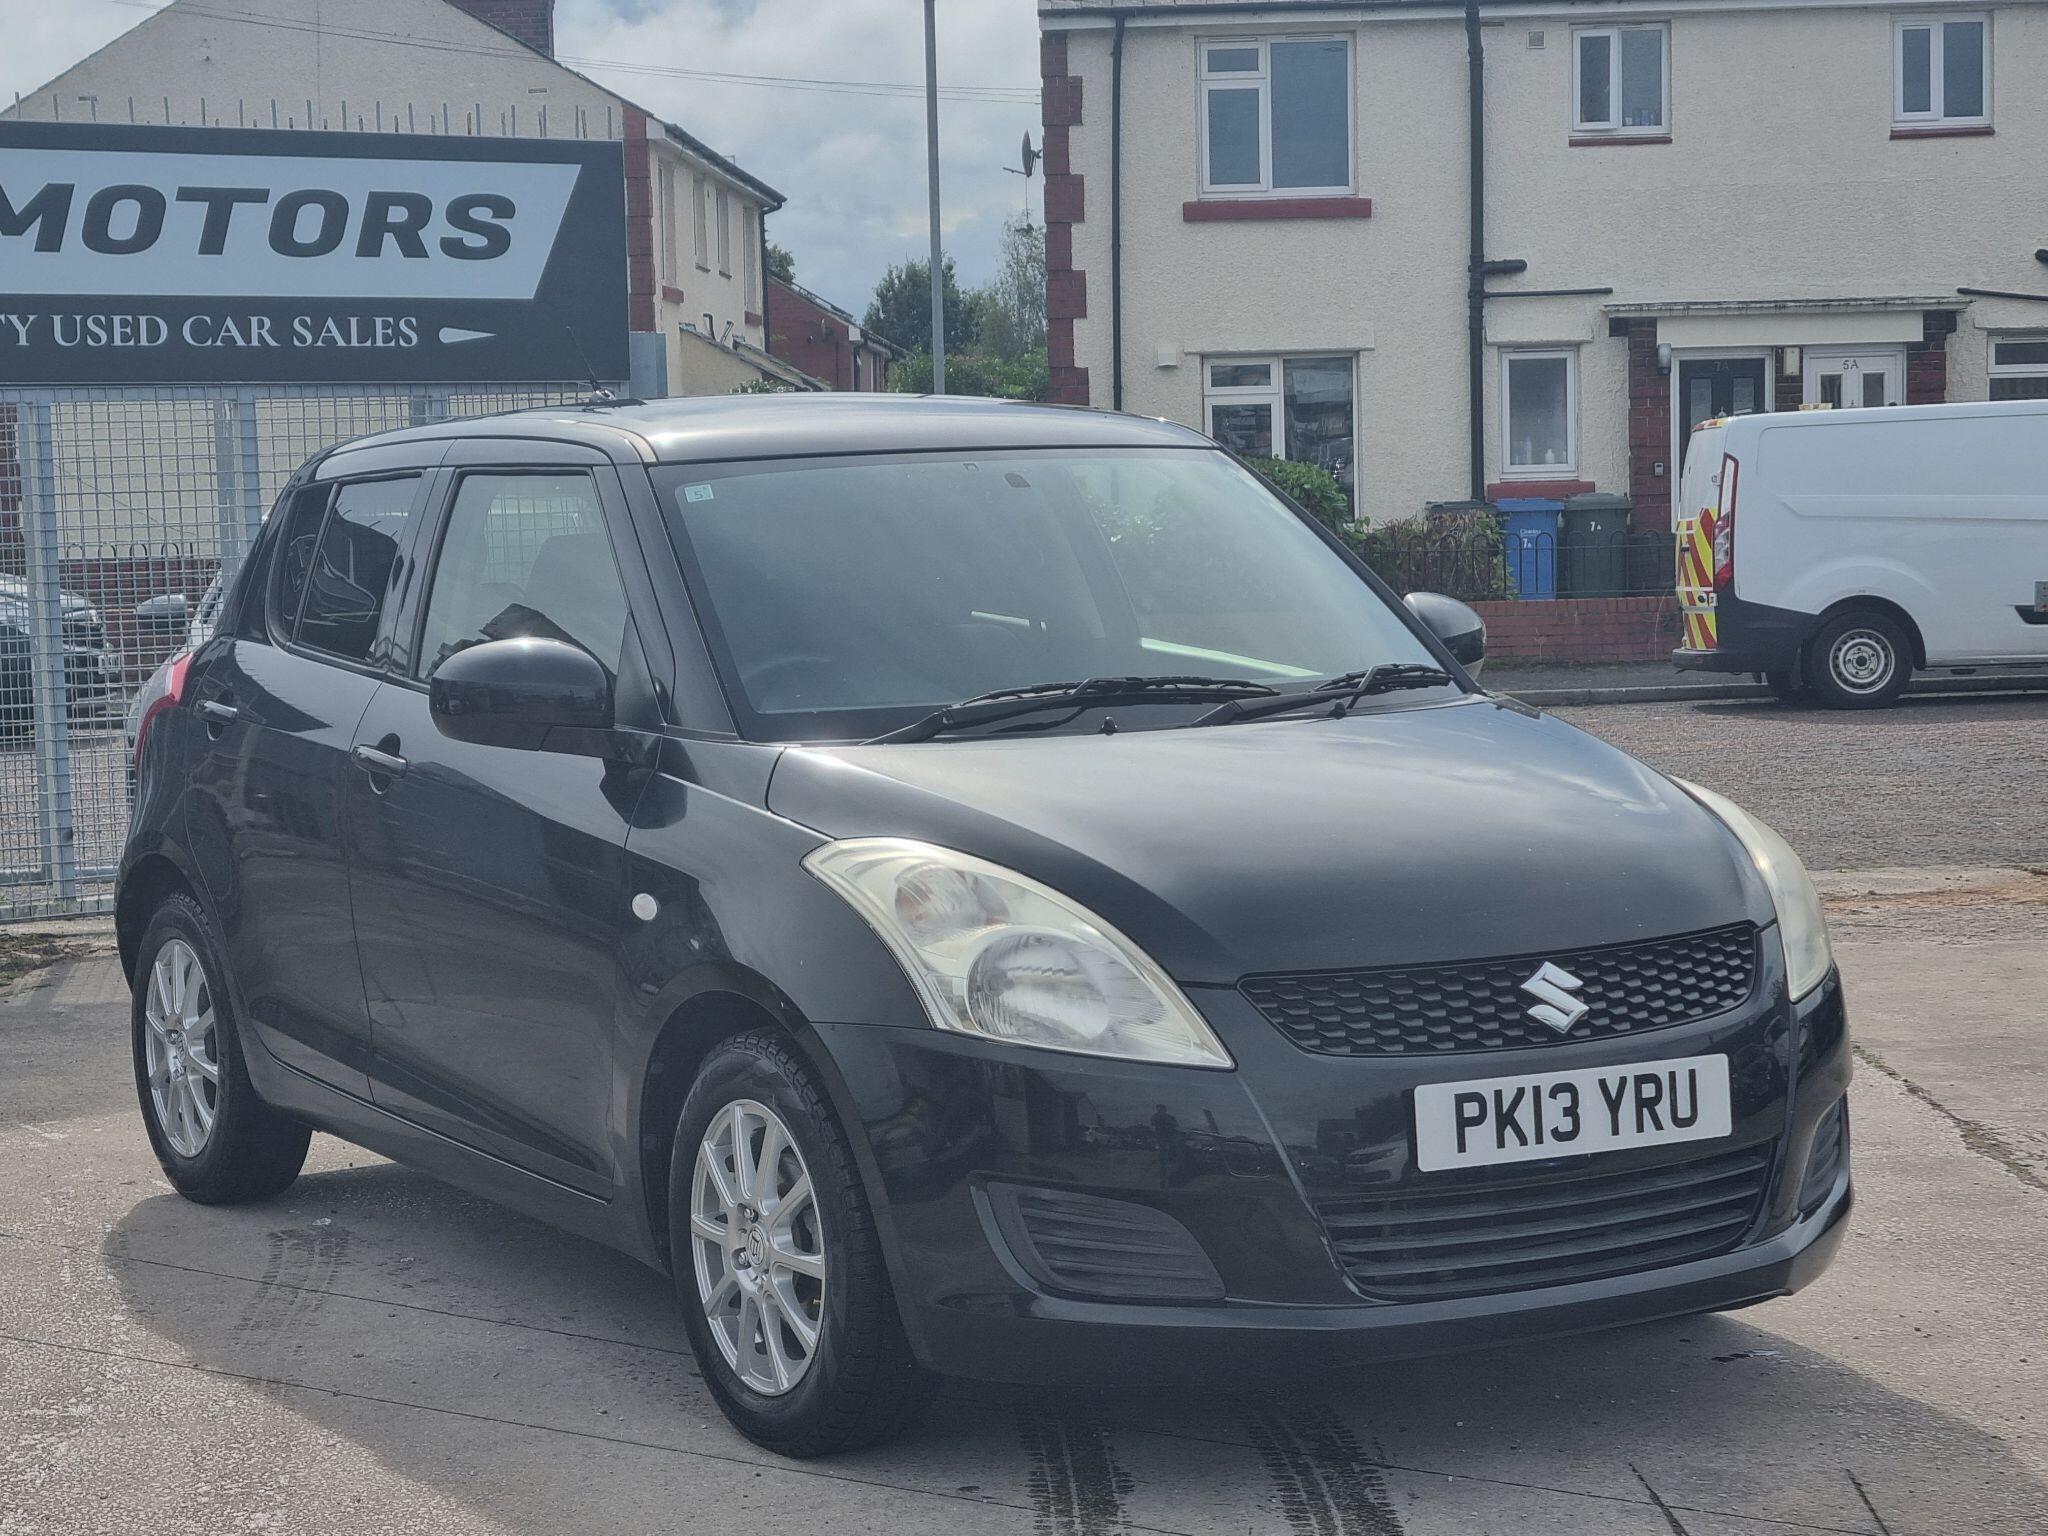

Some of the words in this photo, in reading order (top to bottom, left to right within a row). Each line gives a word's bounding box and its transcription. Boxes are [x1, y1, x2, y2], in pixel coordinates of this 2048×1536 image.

[0, 183, 516, 260] MOTORS
[0, 314, 38, 346] Y
[50, 314, 167, 347] USED
[182, 315, 280, 348] CAR
[293, 316, 418, 347] SALES
[1842, 359, 1860, 370] 5A
[1454, 1082, 1581, 1154] PK13
[1598, 1068, 1699, 1137] YRU
